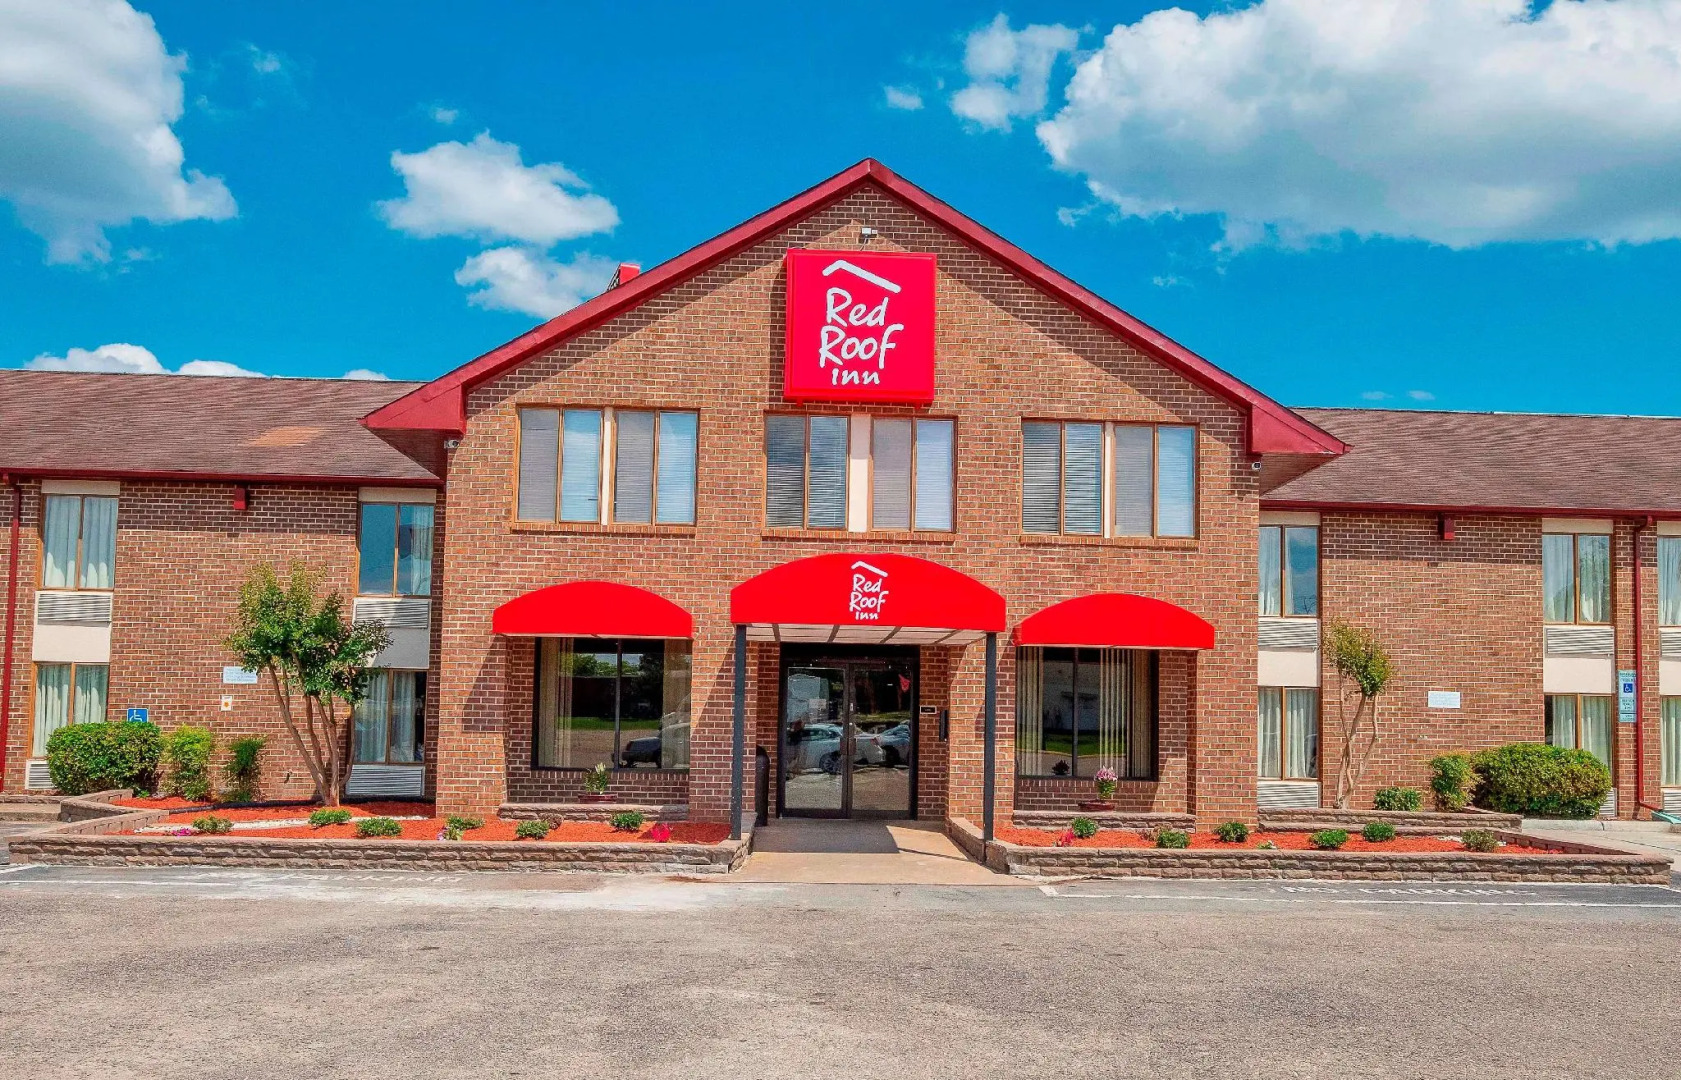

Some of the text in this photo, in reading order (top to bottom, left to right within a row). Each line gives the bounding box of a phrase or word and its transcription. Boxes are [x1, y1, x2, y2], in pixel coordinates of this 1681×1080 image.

[826, 287, 889, 327] Red
[818, 323, 905, 370] Roof
[852, 573, 883, 593] Red
[849, 590, 889, 613] Roof
